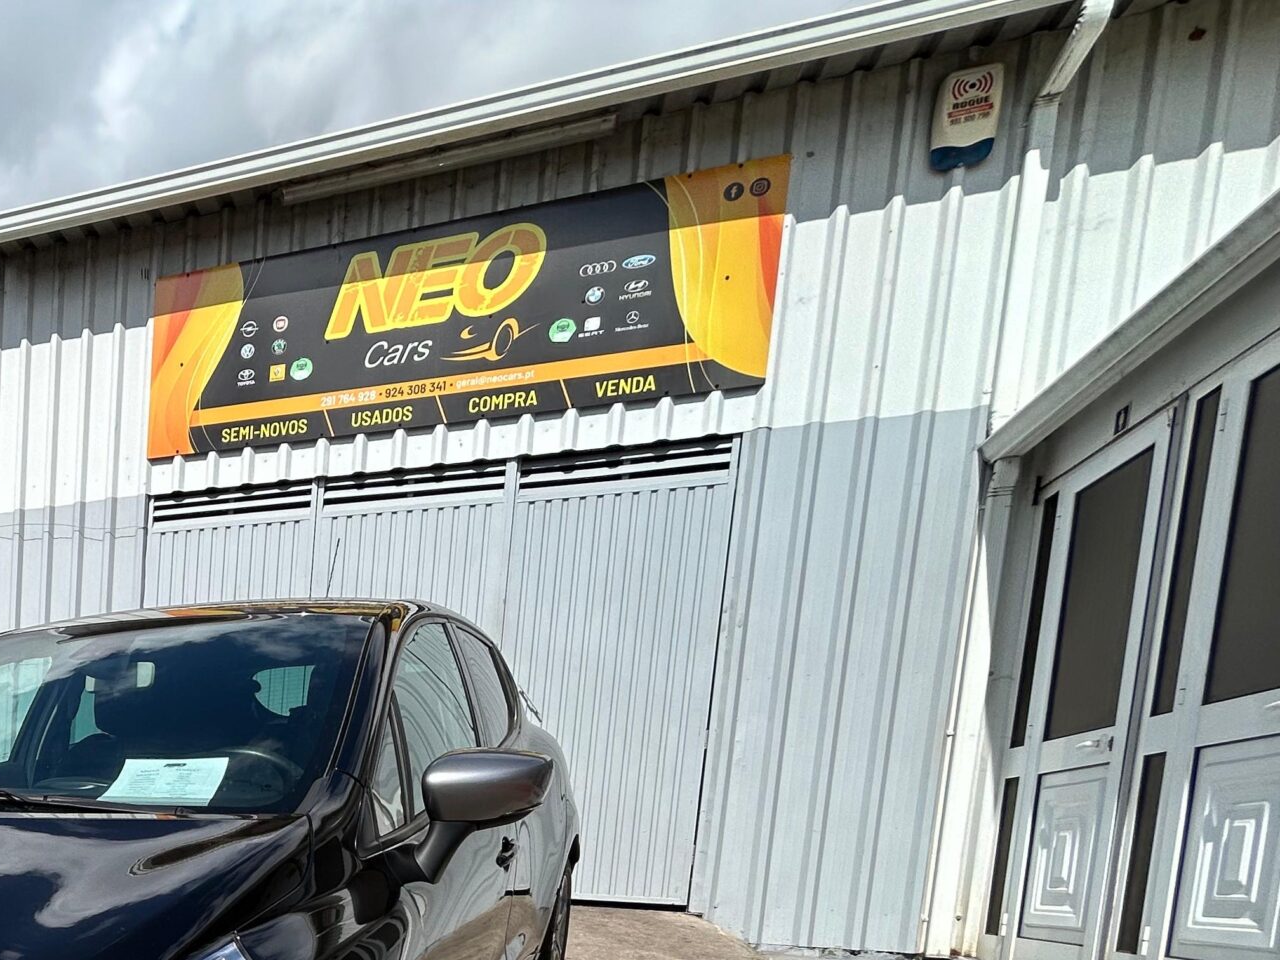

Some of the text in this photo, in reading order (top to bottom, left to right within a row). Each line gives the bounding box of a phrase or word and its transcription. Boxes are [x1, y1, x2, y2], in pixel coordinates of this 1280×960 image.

[324, 222, 547, 340] NEO
[364, 339, 433, 369] Cars
[385, 387, 404, 398] 924
[407, 383, 427, 395] 308
[429, 381, 446, 392] 341
[595, 374, 656, 398] VENDA
[468, 390, 538, 414] COMPRA
[351, 405, 413, 428] USADOS
[221, 418, 308, 443] SEMI-NOVOS
